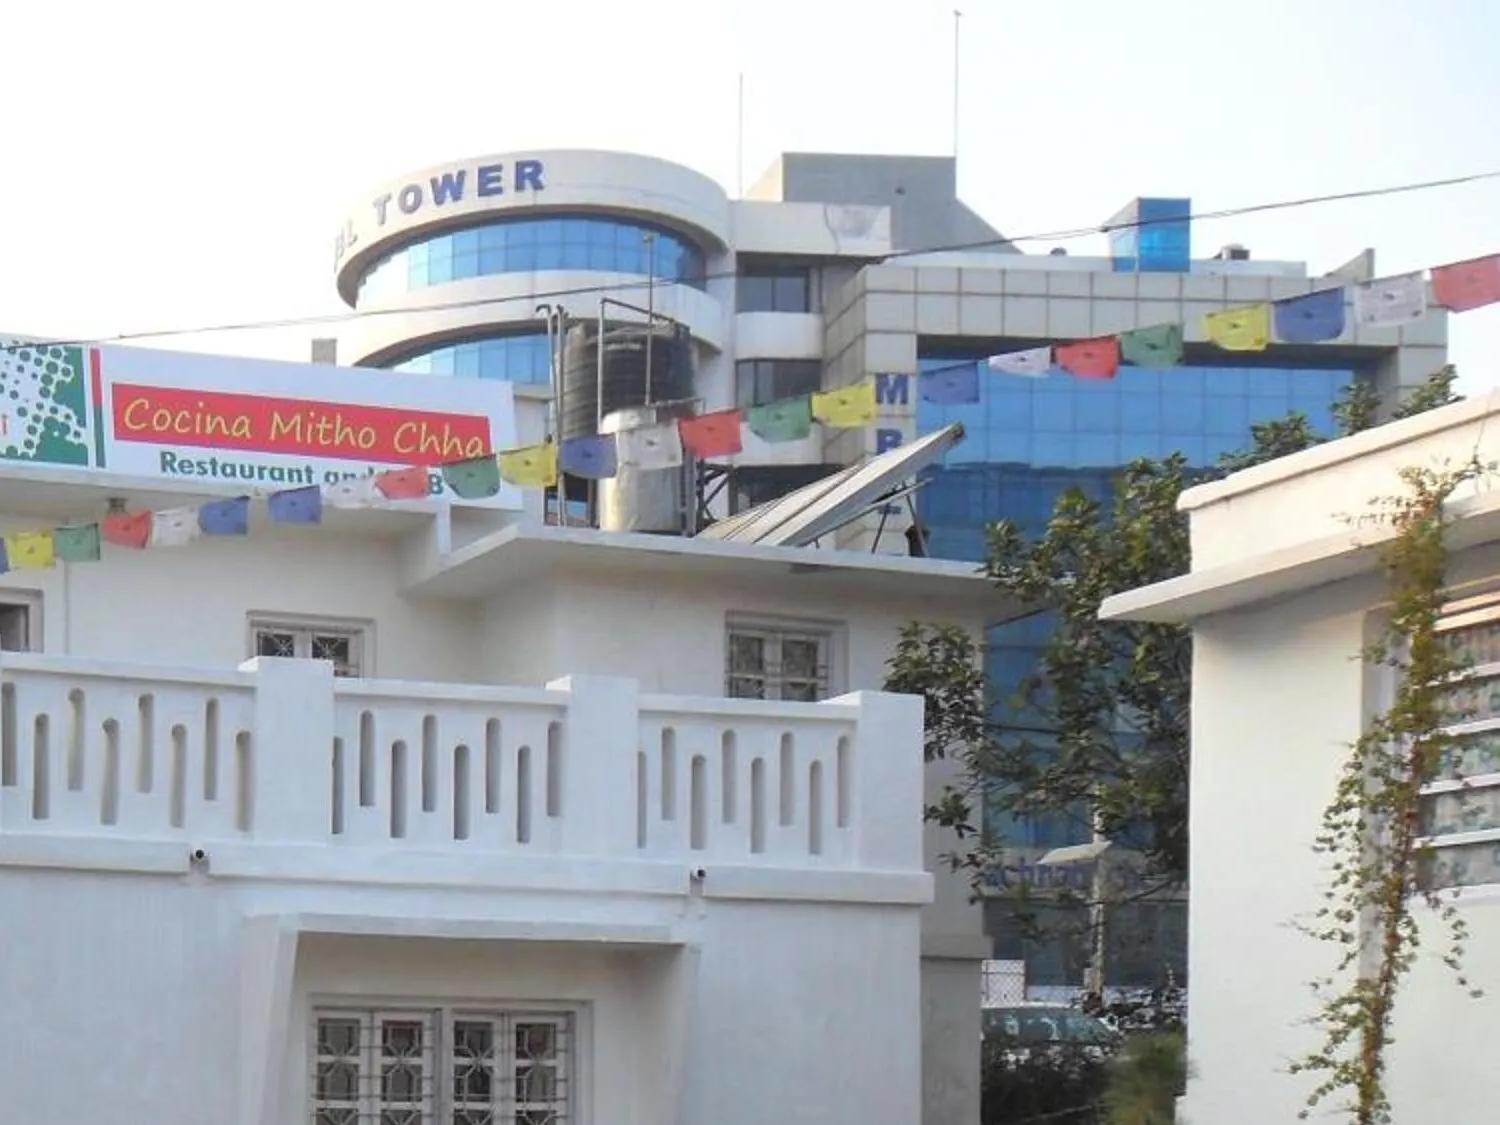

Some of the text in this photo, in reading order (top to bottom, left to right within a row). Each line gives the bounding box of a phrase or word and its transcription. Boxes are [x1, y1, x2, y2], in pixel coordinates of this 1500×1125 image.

[372, 159, 545, 227] TOWER
[124, 397, 484, 459] Cocina Mitho Chha
[159, 450, 314, 485] Restaurant
